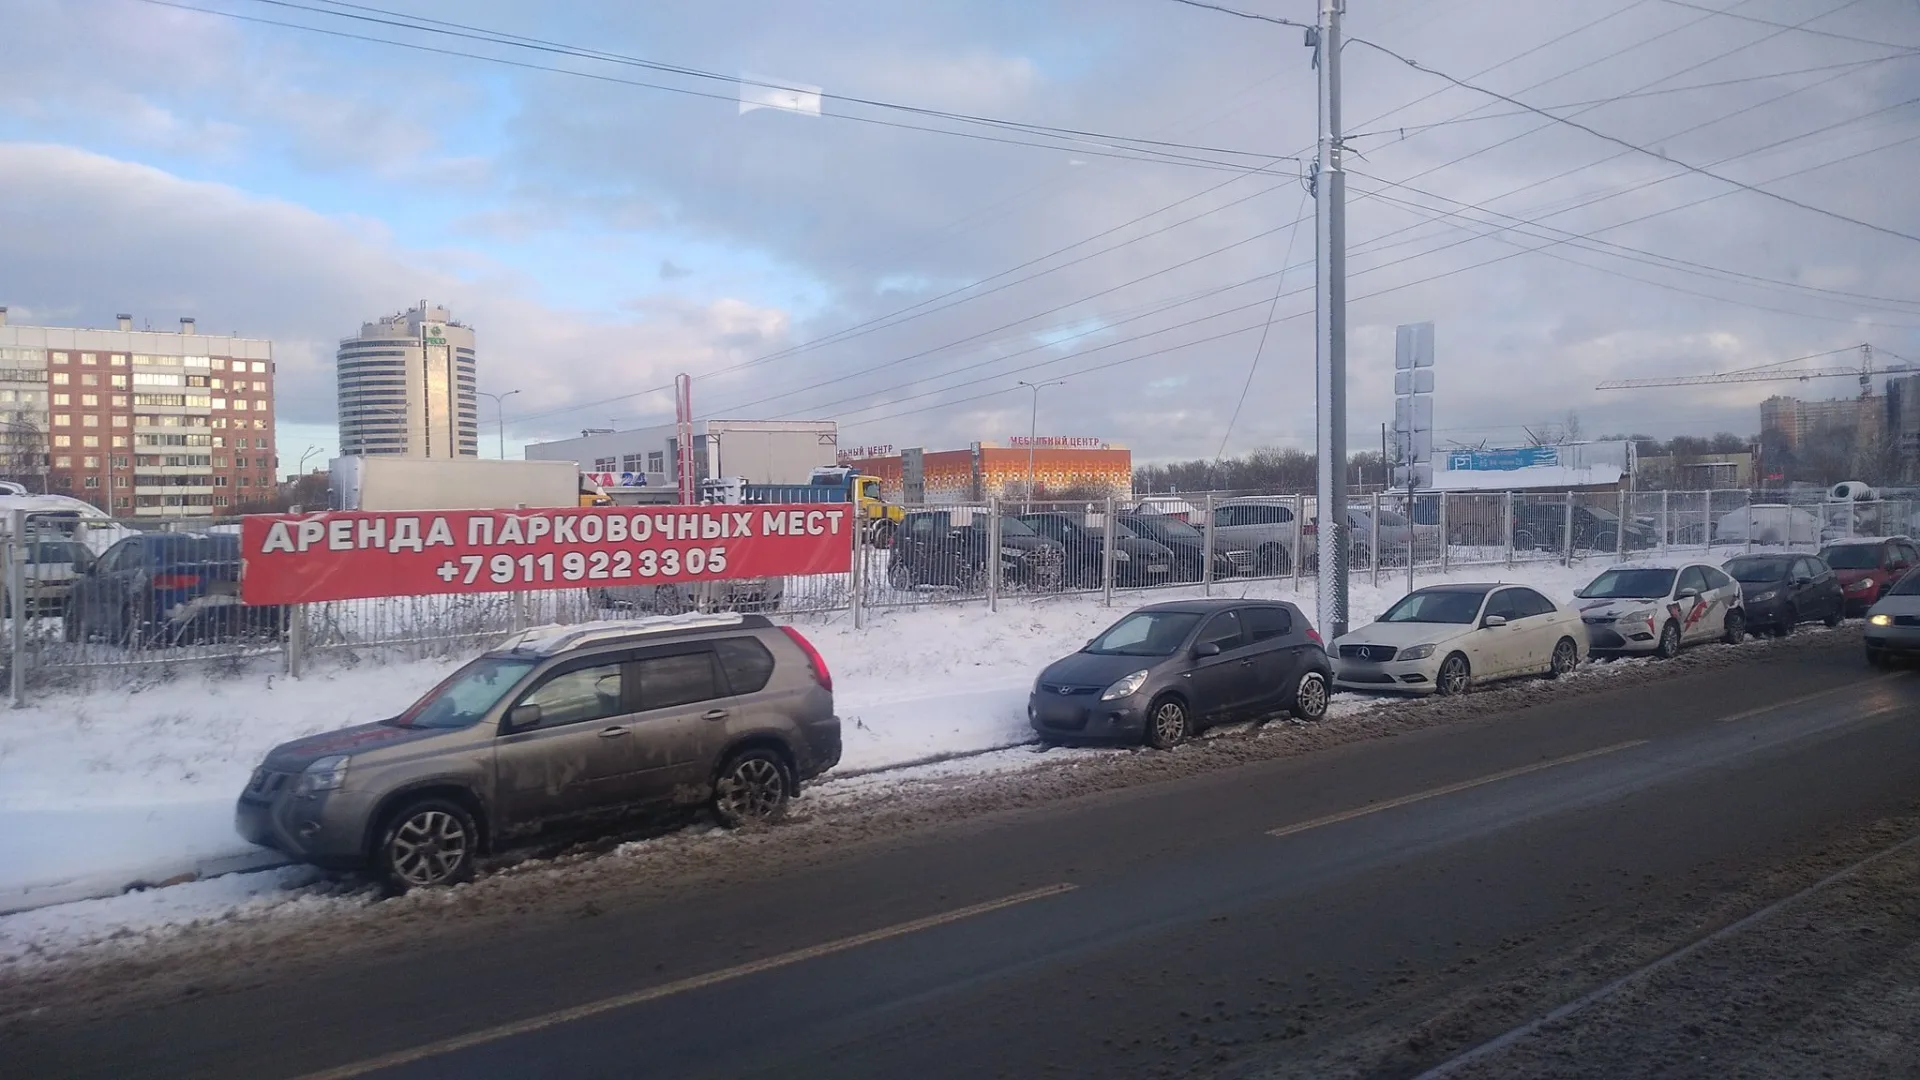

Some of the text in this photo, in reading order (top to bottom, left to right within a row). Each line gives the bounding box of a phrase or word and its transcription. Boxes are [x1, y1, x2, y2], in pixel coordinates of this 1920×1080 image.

[1070, 437, 1100, 447] ЦЕНТР
[867, 444, 893, 456] ЦЕНТР
[621, 472, 647, 487] 24
[261, 510, 843, 553] АРЕНДА ПАРКОВОЧНЫХ МЕСТ
